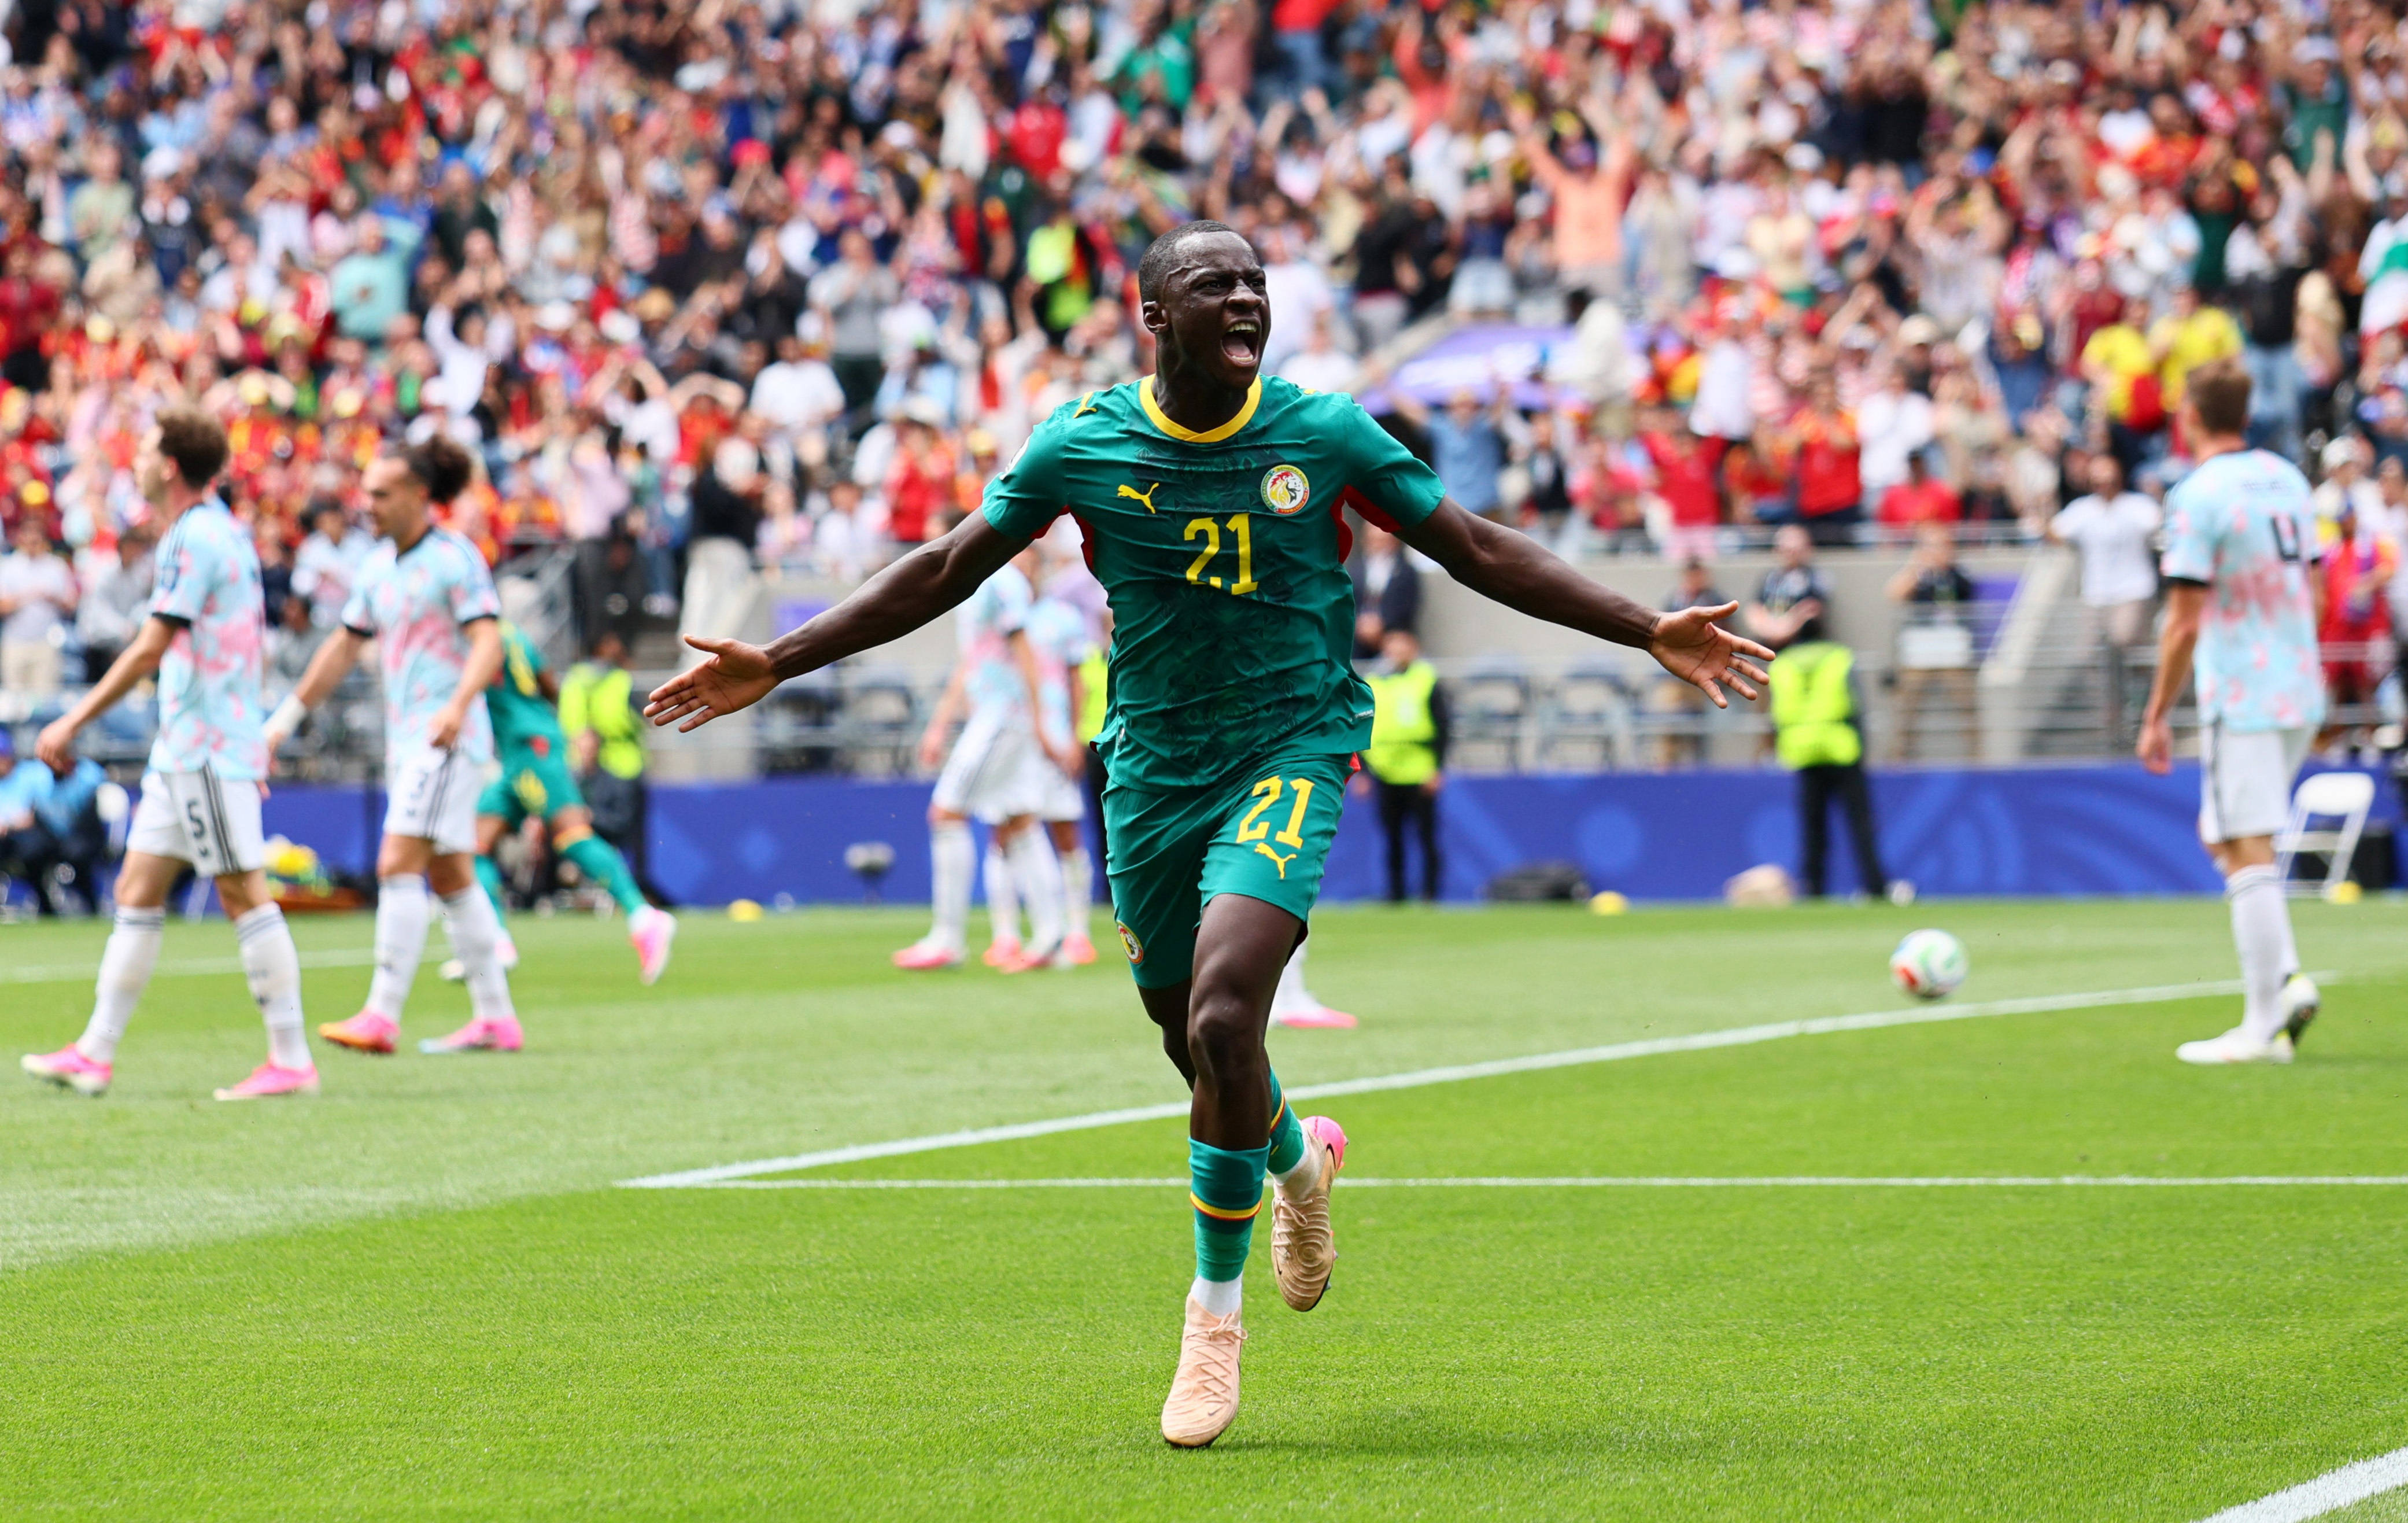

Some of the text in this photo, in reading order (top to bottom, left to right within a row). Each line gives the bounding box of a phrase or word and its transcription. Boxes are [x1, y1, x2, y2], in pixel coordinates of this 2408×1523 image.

[1184, 513, 1258, 595] 21
[187, 799, 205, 838] 5
[1236, 775, 1315, 849] 21
